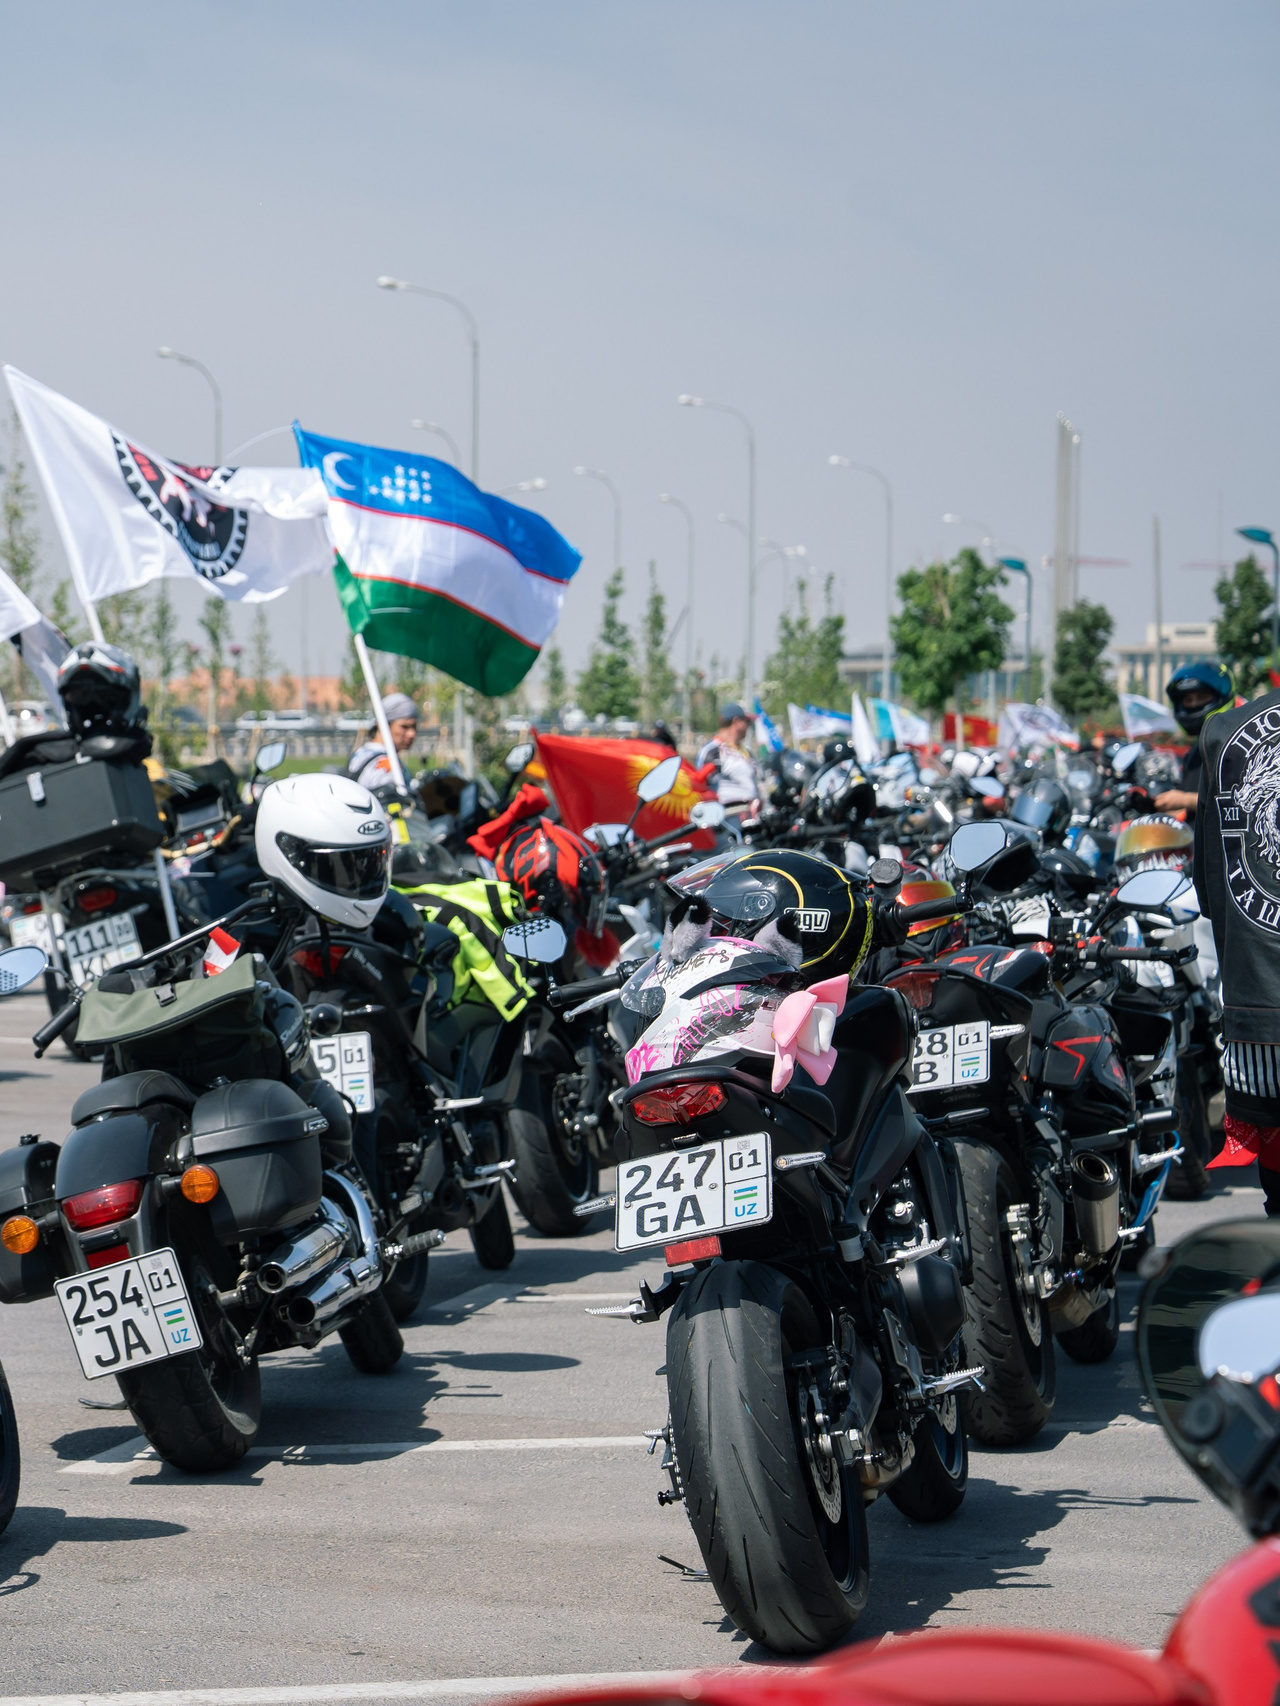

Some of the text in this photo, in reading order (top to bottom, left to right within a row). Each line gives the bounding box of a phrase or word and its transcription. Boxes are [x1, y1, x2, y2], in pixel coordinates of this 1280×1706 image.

[1223, 807, 1239, 821] XII
[70, 924, 112, 958] 111
[959, 1031, 983, 1046] 01
[344, 1048, 365, 1064] 01
[961, 1068, 979, 1078] UZ
[729, 1149, 761, 1171] 01
[625, 1149, 717, 1203] 247
[636, 1195, 706, 1238] GA
[734, 1203, 757, 1217] UZ
[148, 1268, 177, 1292] 01
[66, 1269, 144, 1327] 254
[94, 1318, 152, 1368] JA
[171, 1328, 191, 1344] UZ
